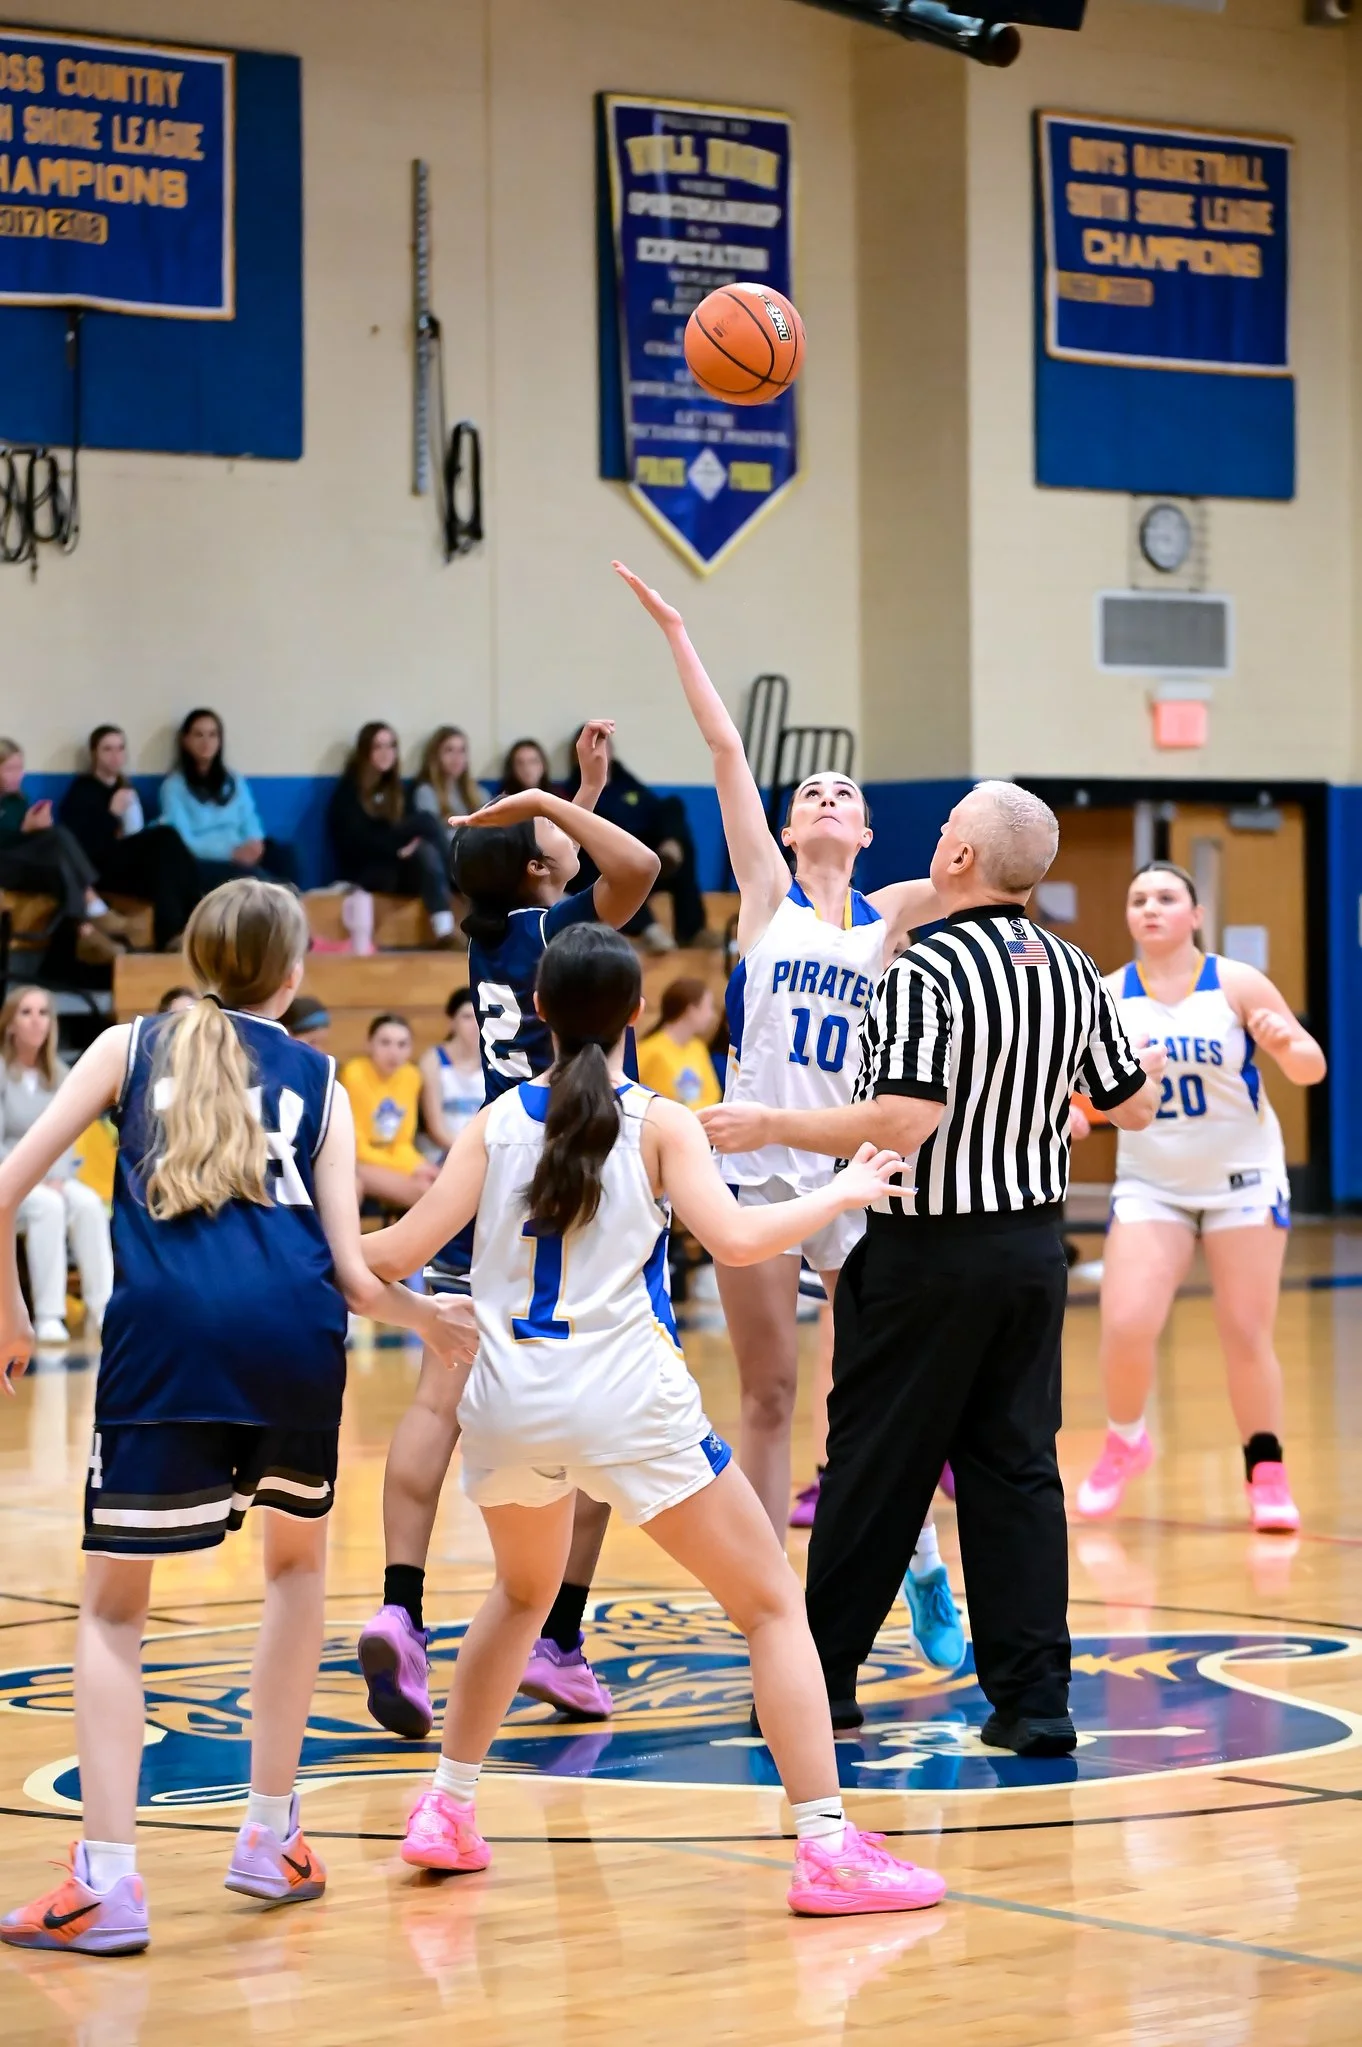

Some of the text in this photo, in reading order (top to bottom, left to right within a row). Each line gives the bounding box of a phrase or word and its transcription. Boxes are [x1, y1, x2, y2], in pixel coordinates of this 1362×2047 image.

[57, 58, 184, 108] COUNTRY
[112, 114, 205, 160] LEAGUE
[1082, 228, 1263, 278] CHAMPIONS
[788, 1007, 850, 1073] 10
[1147, 1035, 1223, 1066] ATES
[1156, 1074, 1207, 1119] 20
[510, 1216, 573, 1342] 1
